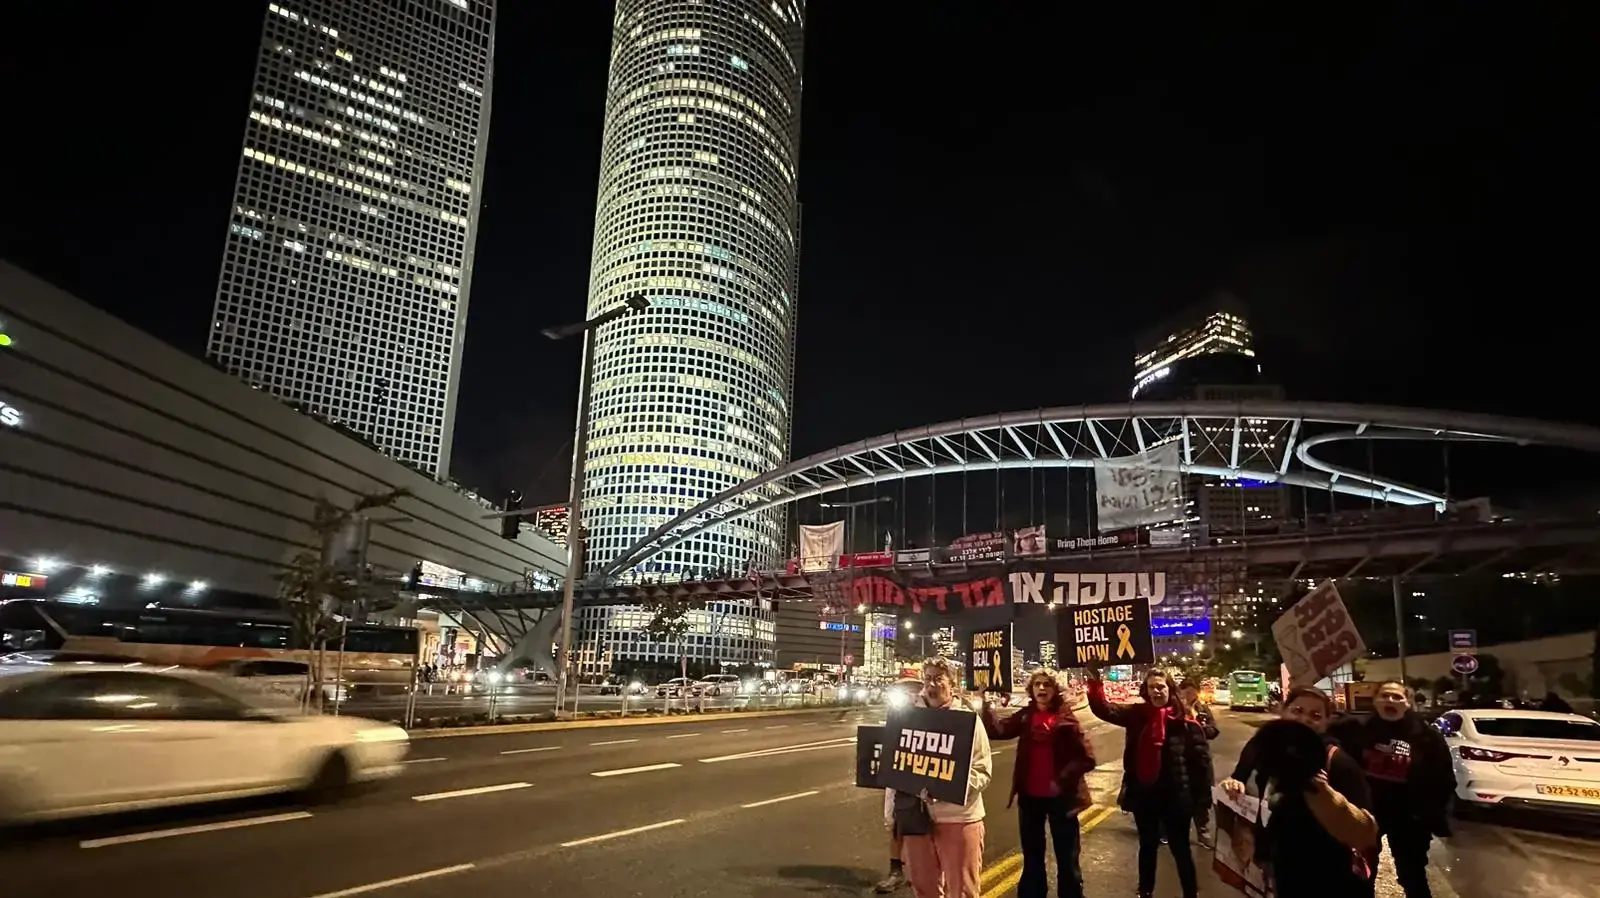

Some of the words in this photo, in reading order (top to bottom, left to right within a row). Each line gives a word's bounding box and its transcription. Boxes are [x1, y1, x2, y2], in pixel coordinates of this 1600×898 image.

[1057, 539, 1075, 549] Bring
[1077, 537, 1096, 547] Them
[1098, 535, 1119, 545] Home
[953, 577, 1006, 609] גזר
[1008, 572, 1045, 603] או
[1053, 572, 1166, 606] עסקה
[1074, 605, 1134, 626] HOSTAGE
[973, 630, 1003, 649] HOSTAGE
[1075, 625, 1109, 643] DEAL
[973, 650, 990, 667] DEAL
[1076, 643, 1110, 663] NOW
[974, 669, 990, 688] NOW
[900, 728, 955, 755] עסקה
[892, 750, 956, 781] עכשיו!
